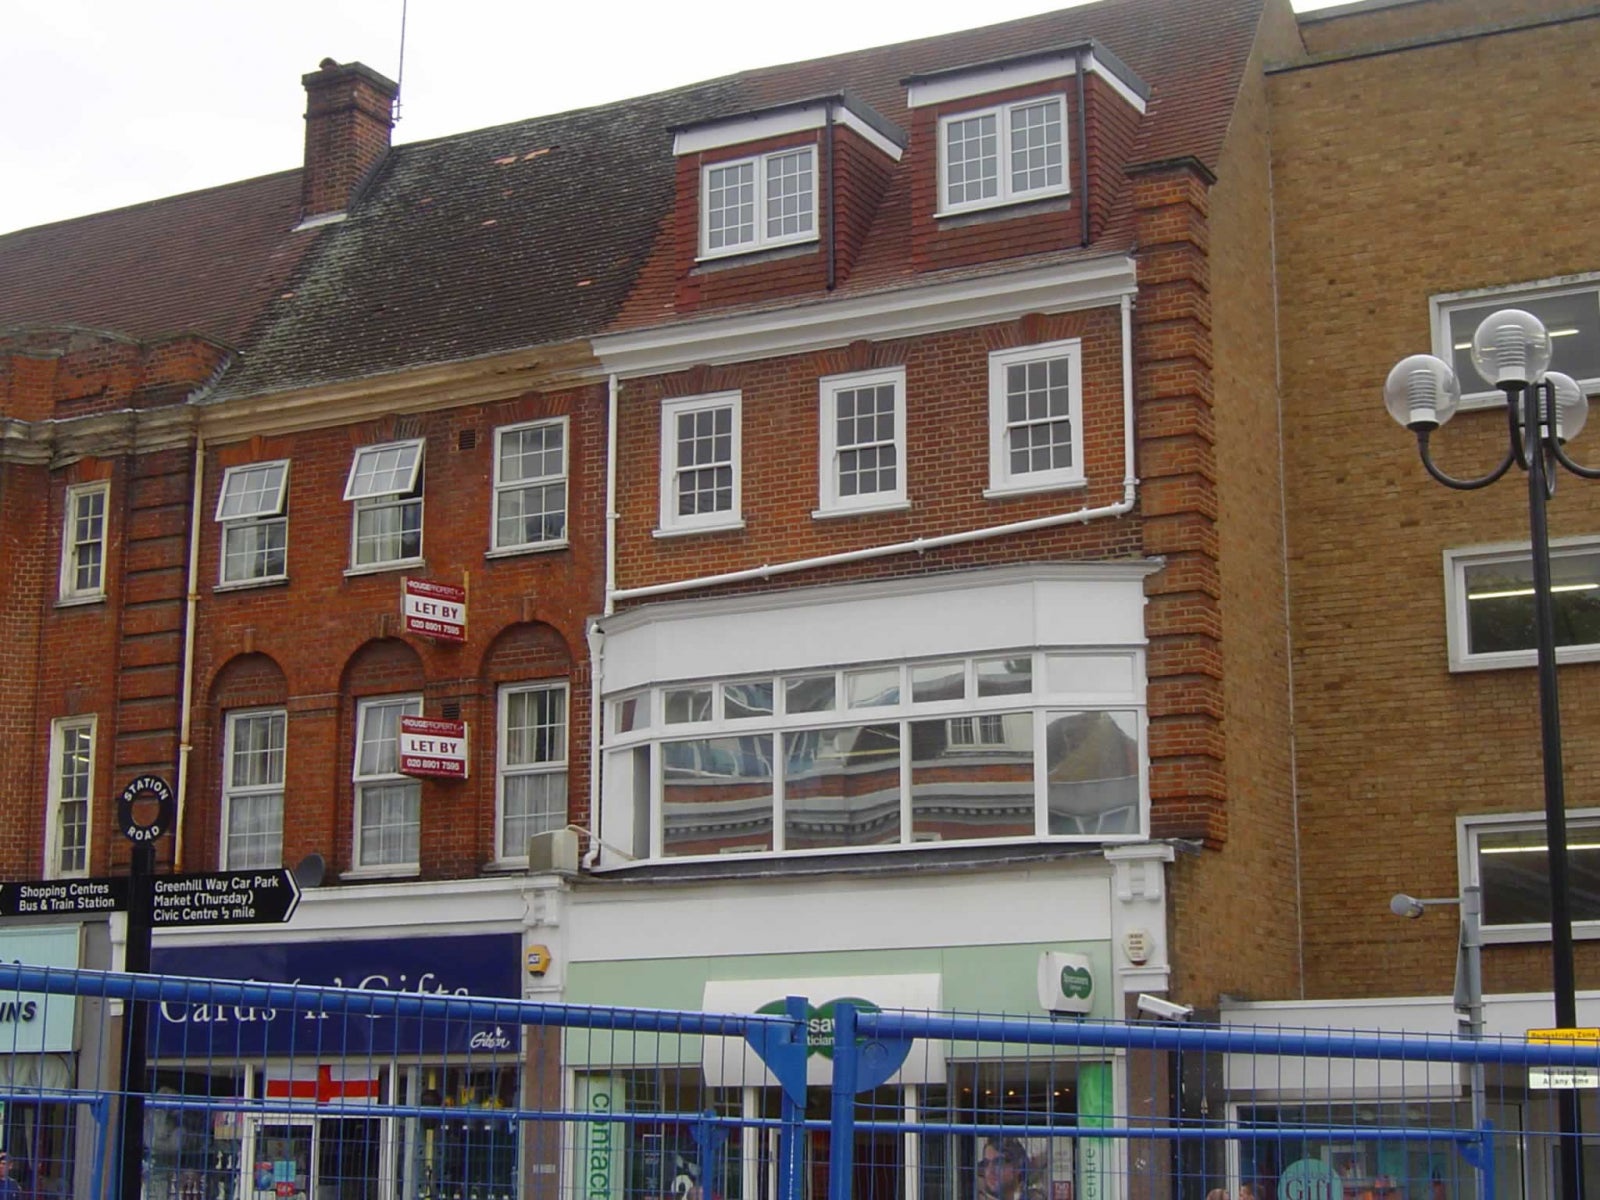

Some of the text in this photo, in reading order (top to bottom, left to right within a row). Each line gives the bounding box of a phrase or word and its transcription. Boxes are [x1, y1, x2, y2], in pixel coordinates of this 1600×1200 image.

[415, 601, 458, 620] LET BY
[411, 740, 457, 755] LET BY
[124, 778, 169, 801] STATION
[127, 826, 160, 841] ROAD
[20, 882, 109, 899] Shopping Centres
[154, 875, 279, 893] Greenhill Way Car Park
[19, 896, 115, 912] Bus & Train Station
[153, 889, 254, 907] Market (Thursday)
[153, 908, 179, 921] Civic
[182, 907, 219, 920] Centre
[232, 906, 256, 918] mile
[1577, 1030, 1596, 1038] Zone
